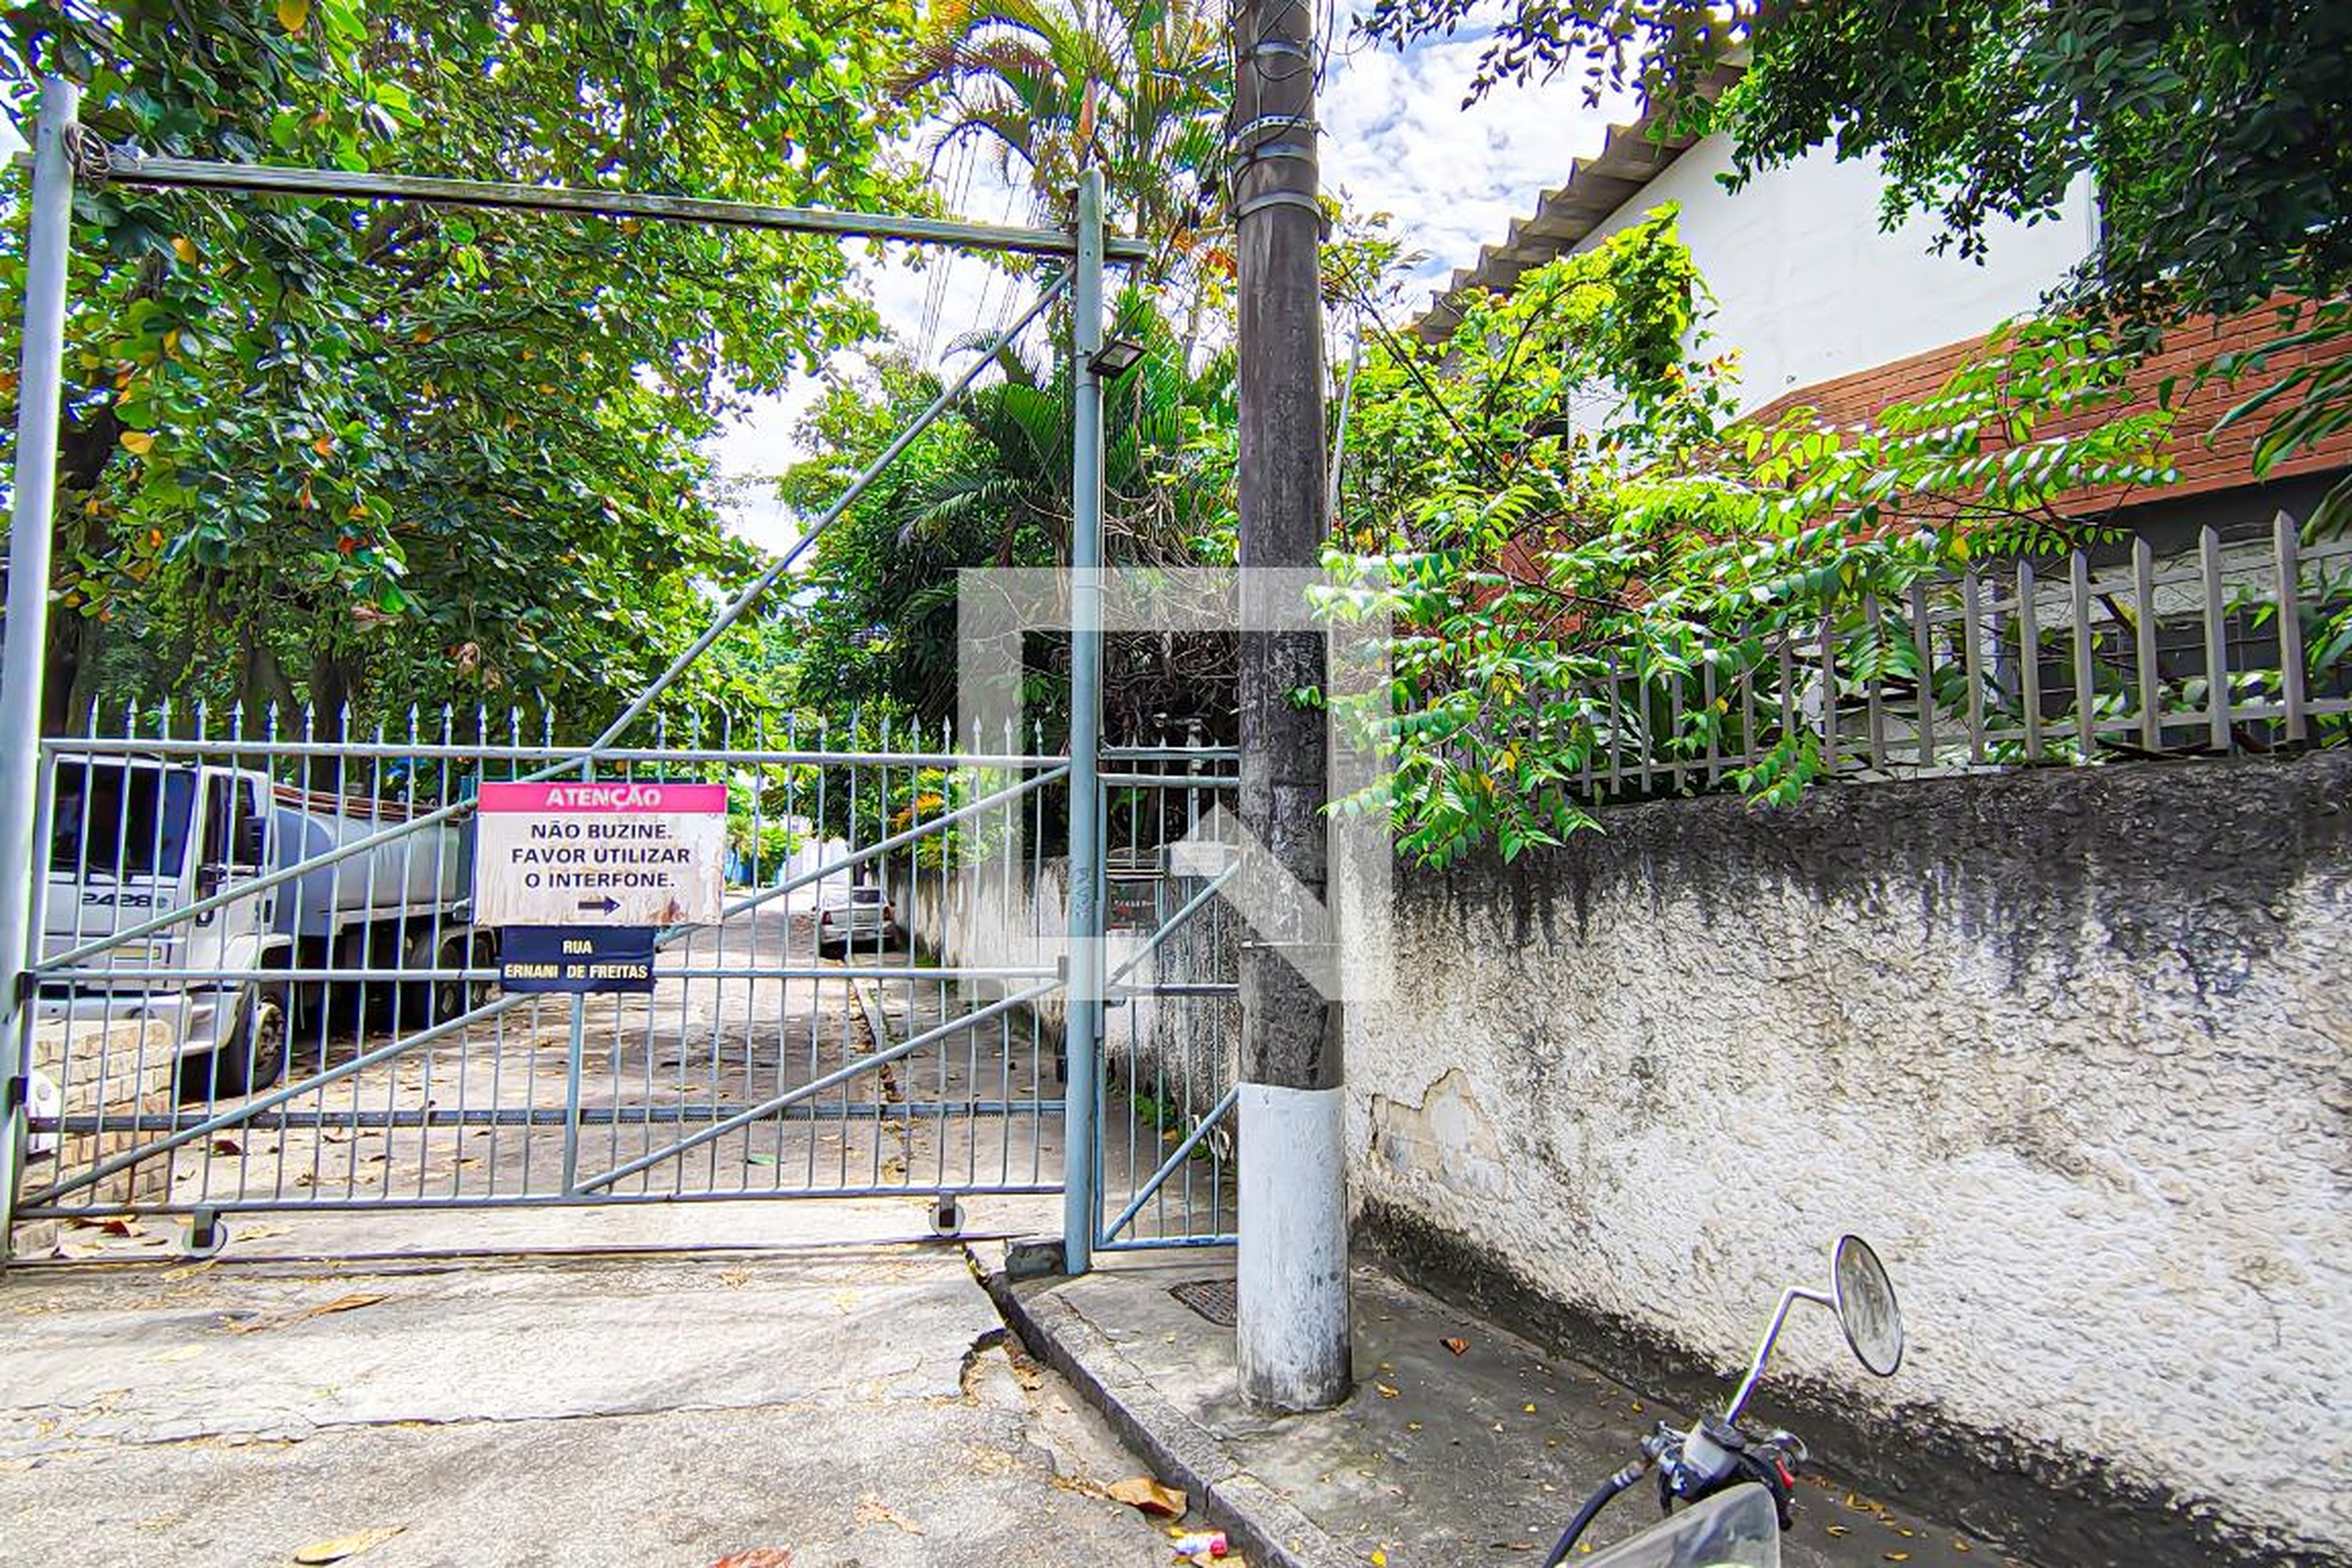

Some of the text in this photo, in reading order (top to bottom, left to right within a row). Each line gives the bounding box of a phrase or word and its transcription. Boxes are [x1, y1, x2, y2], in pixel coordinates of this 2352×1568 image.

[545, 784, 662, 811] ATENÇÃO
[531, 820, 673, 839] NÃO BUZINE.
[511, 848, 690, 864] FAVOR UTILIZAR
[525, 873, 675, 888] O INTERFONE.
[562, 940, 594, 954] RUA
[503, 964, 649, 979] ERNANI DE FREITAS
